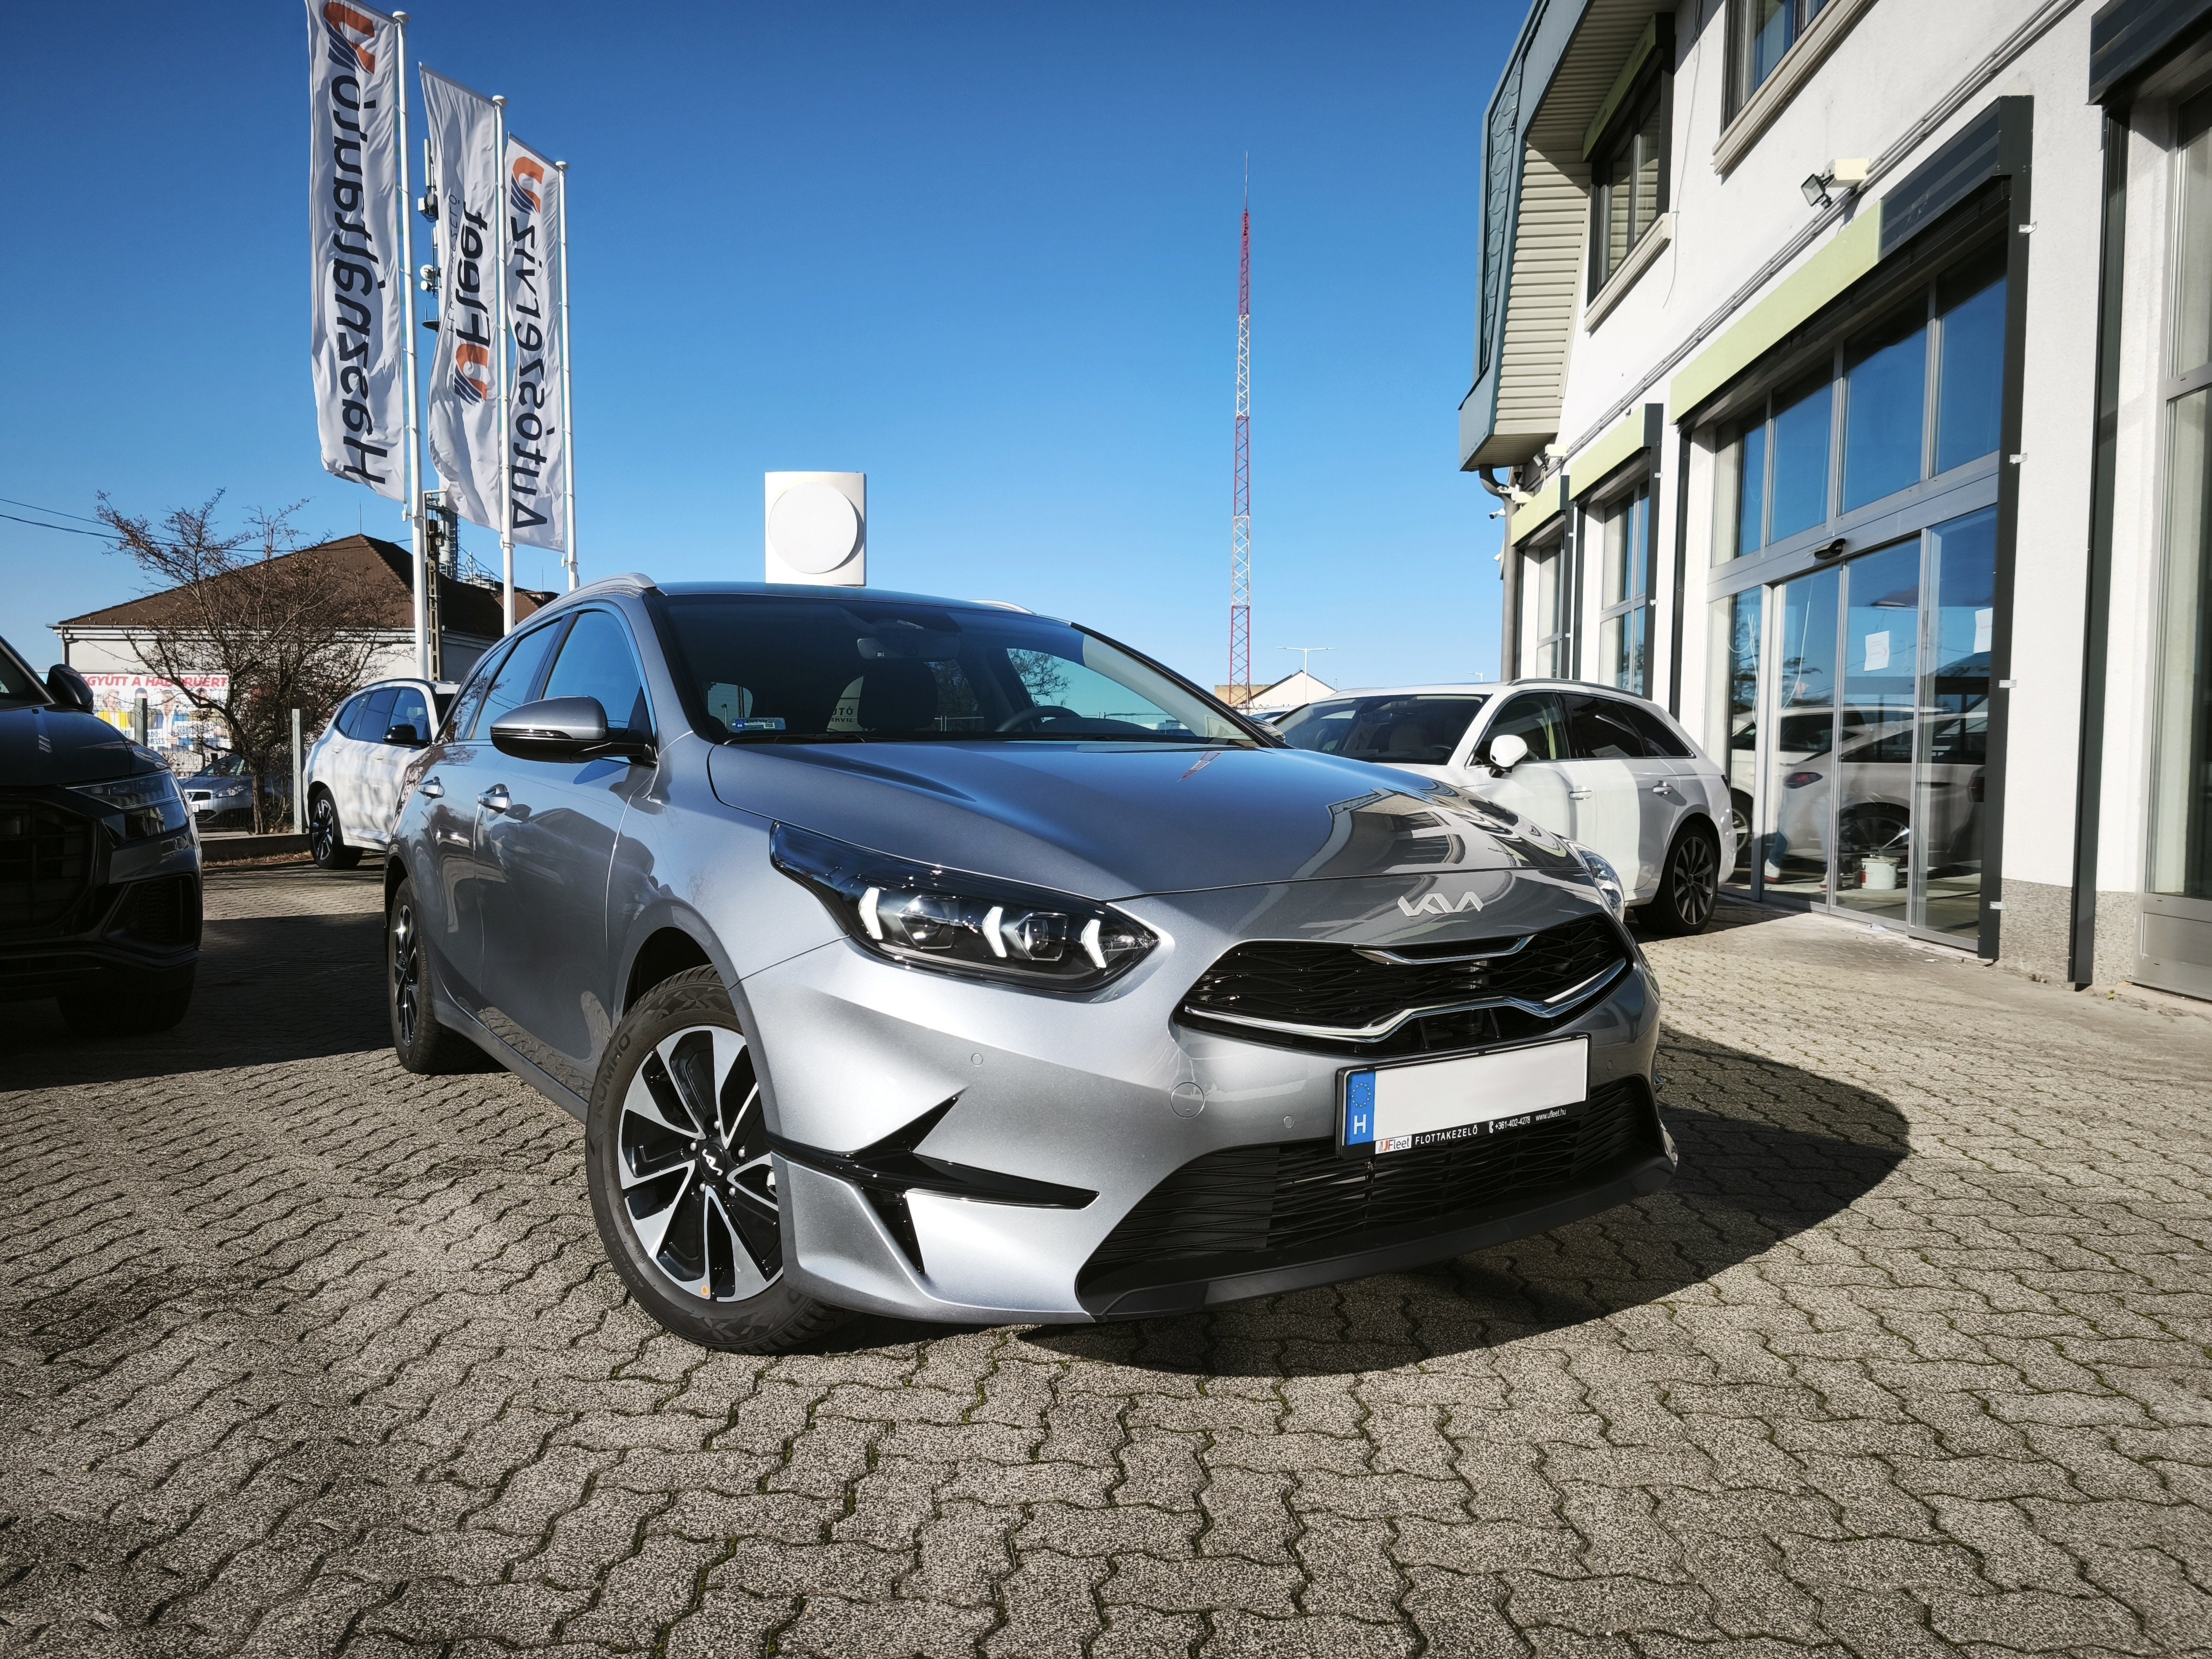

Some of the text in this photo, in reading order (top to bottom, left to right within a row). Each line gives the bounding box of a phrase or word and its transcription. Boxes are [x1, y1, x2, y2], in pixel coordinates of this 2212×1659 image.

[84, 673, 129, 686] GYÜTT
[131, 677, 141, 686] A
[1397, 891, 1484, 917] KIA
[593, 1031, 631, 1120] KUMHO
[1354, 1114, 1367, 1135] H
[1378, 1124, 1479, 1152] UFleet FLOTTAKEZELŐ
